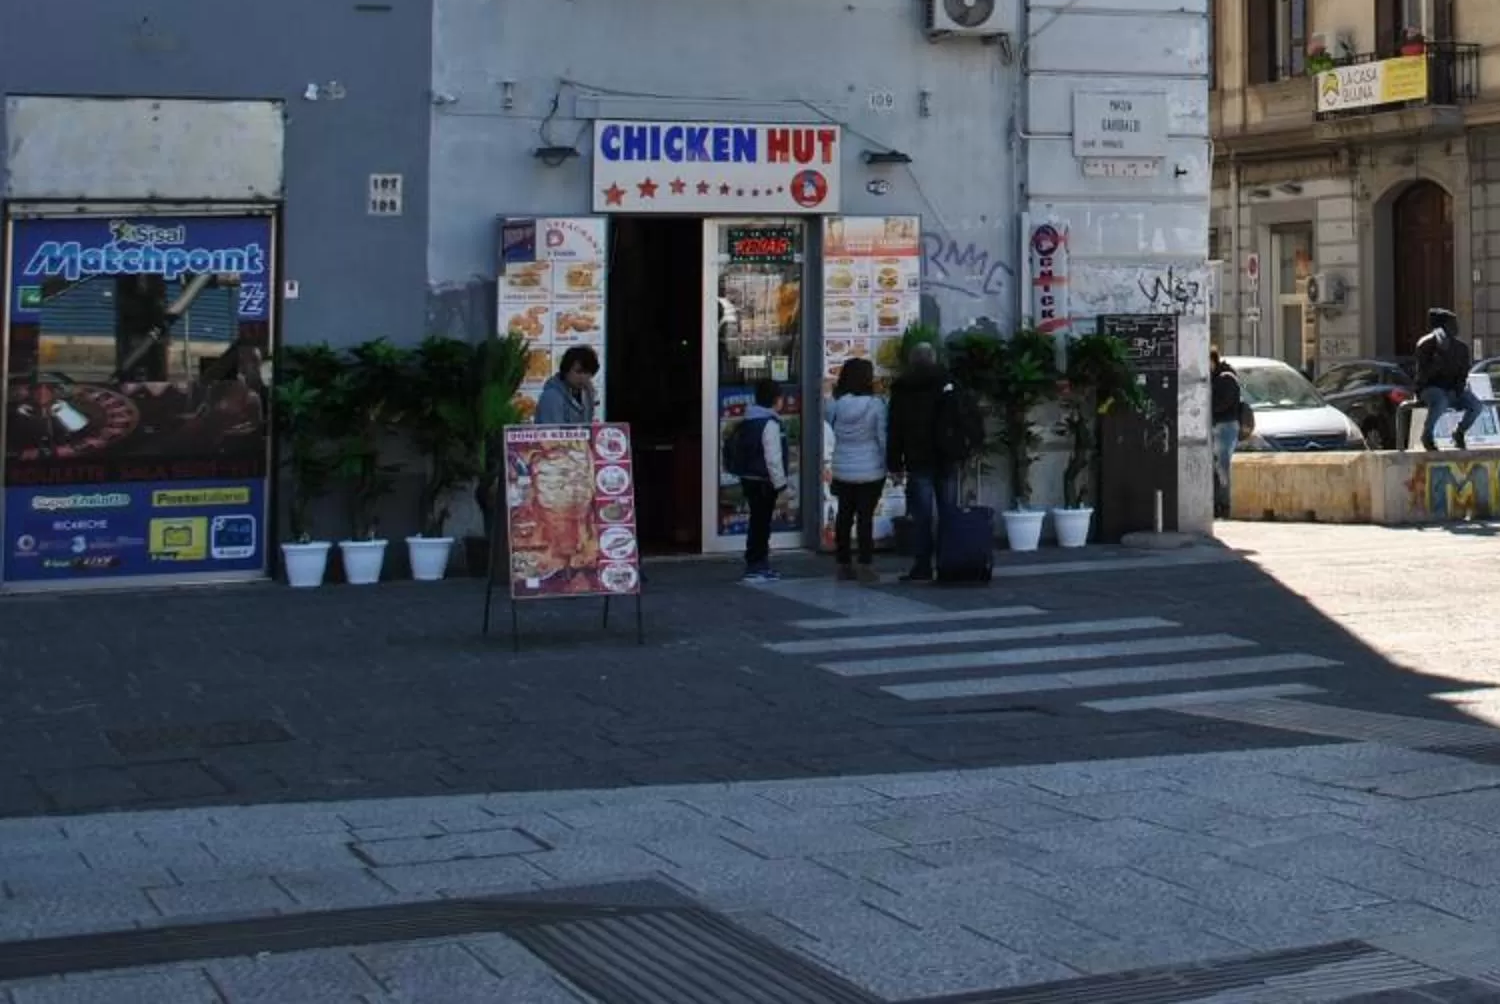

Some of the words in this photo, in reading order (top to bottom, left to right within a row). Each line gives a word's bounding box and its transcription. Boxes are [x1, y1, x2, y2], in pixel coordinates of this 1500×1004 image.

[600, 124, 758, 163] CHICKEN
[766, 128, 837, 164] HUT
[136, 224, 186, 244] Sisal
[24, 242, 267, 281] Matchpoint
